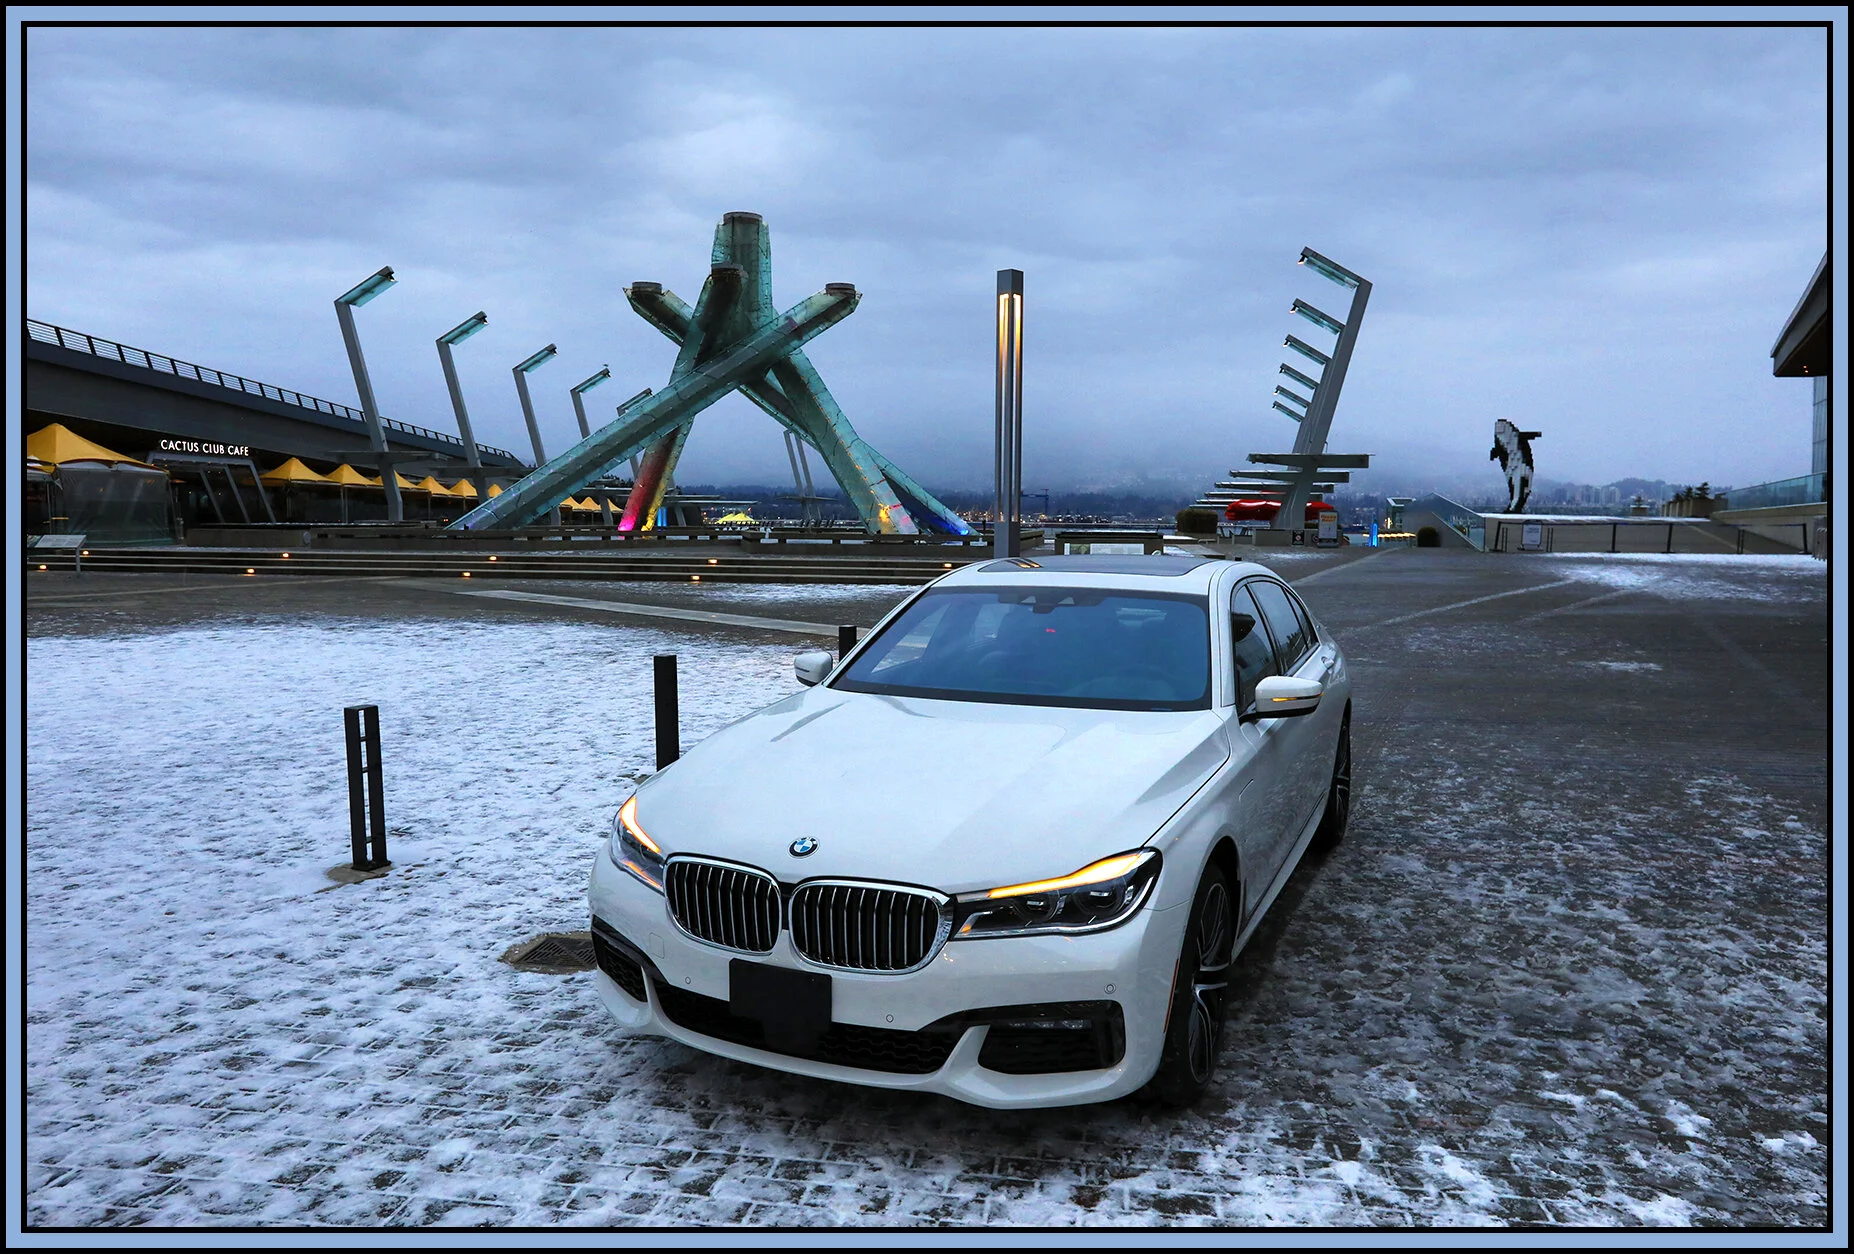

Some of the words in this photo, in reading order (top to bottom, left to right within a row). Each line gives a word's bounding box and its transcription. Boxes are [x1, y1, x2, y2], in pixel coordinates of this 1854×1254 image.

[161, 440, 199, 452] CACTUS
[203, 443, 225, 454] CLUB
[228, 445, 249, 456] CAFE
